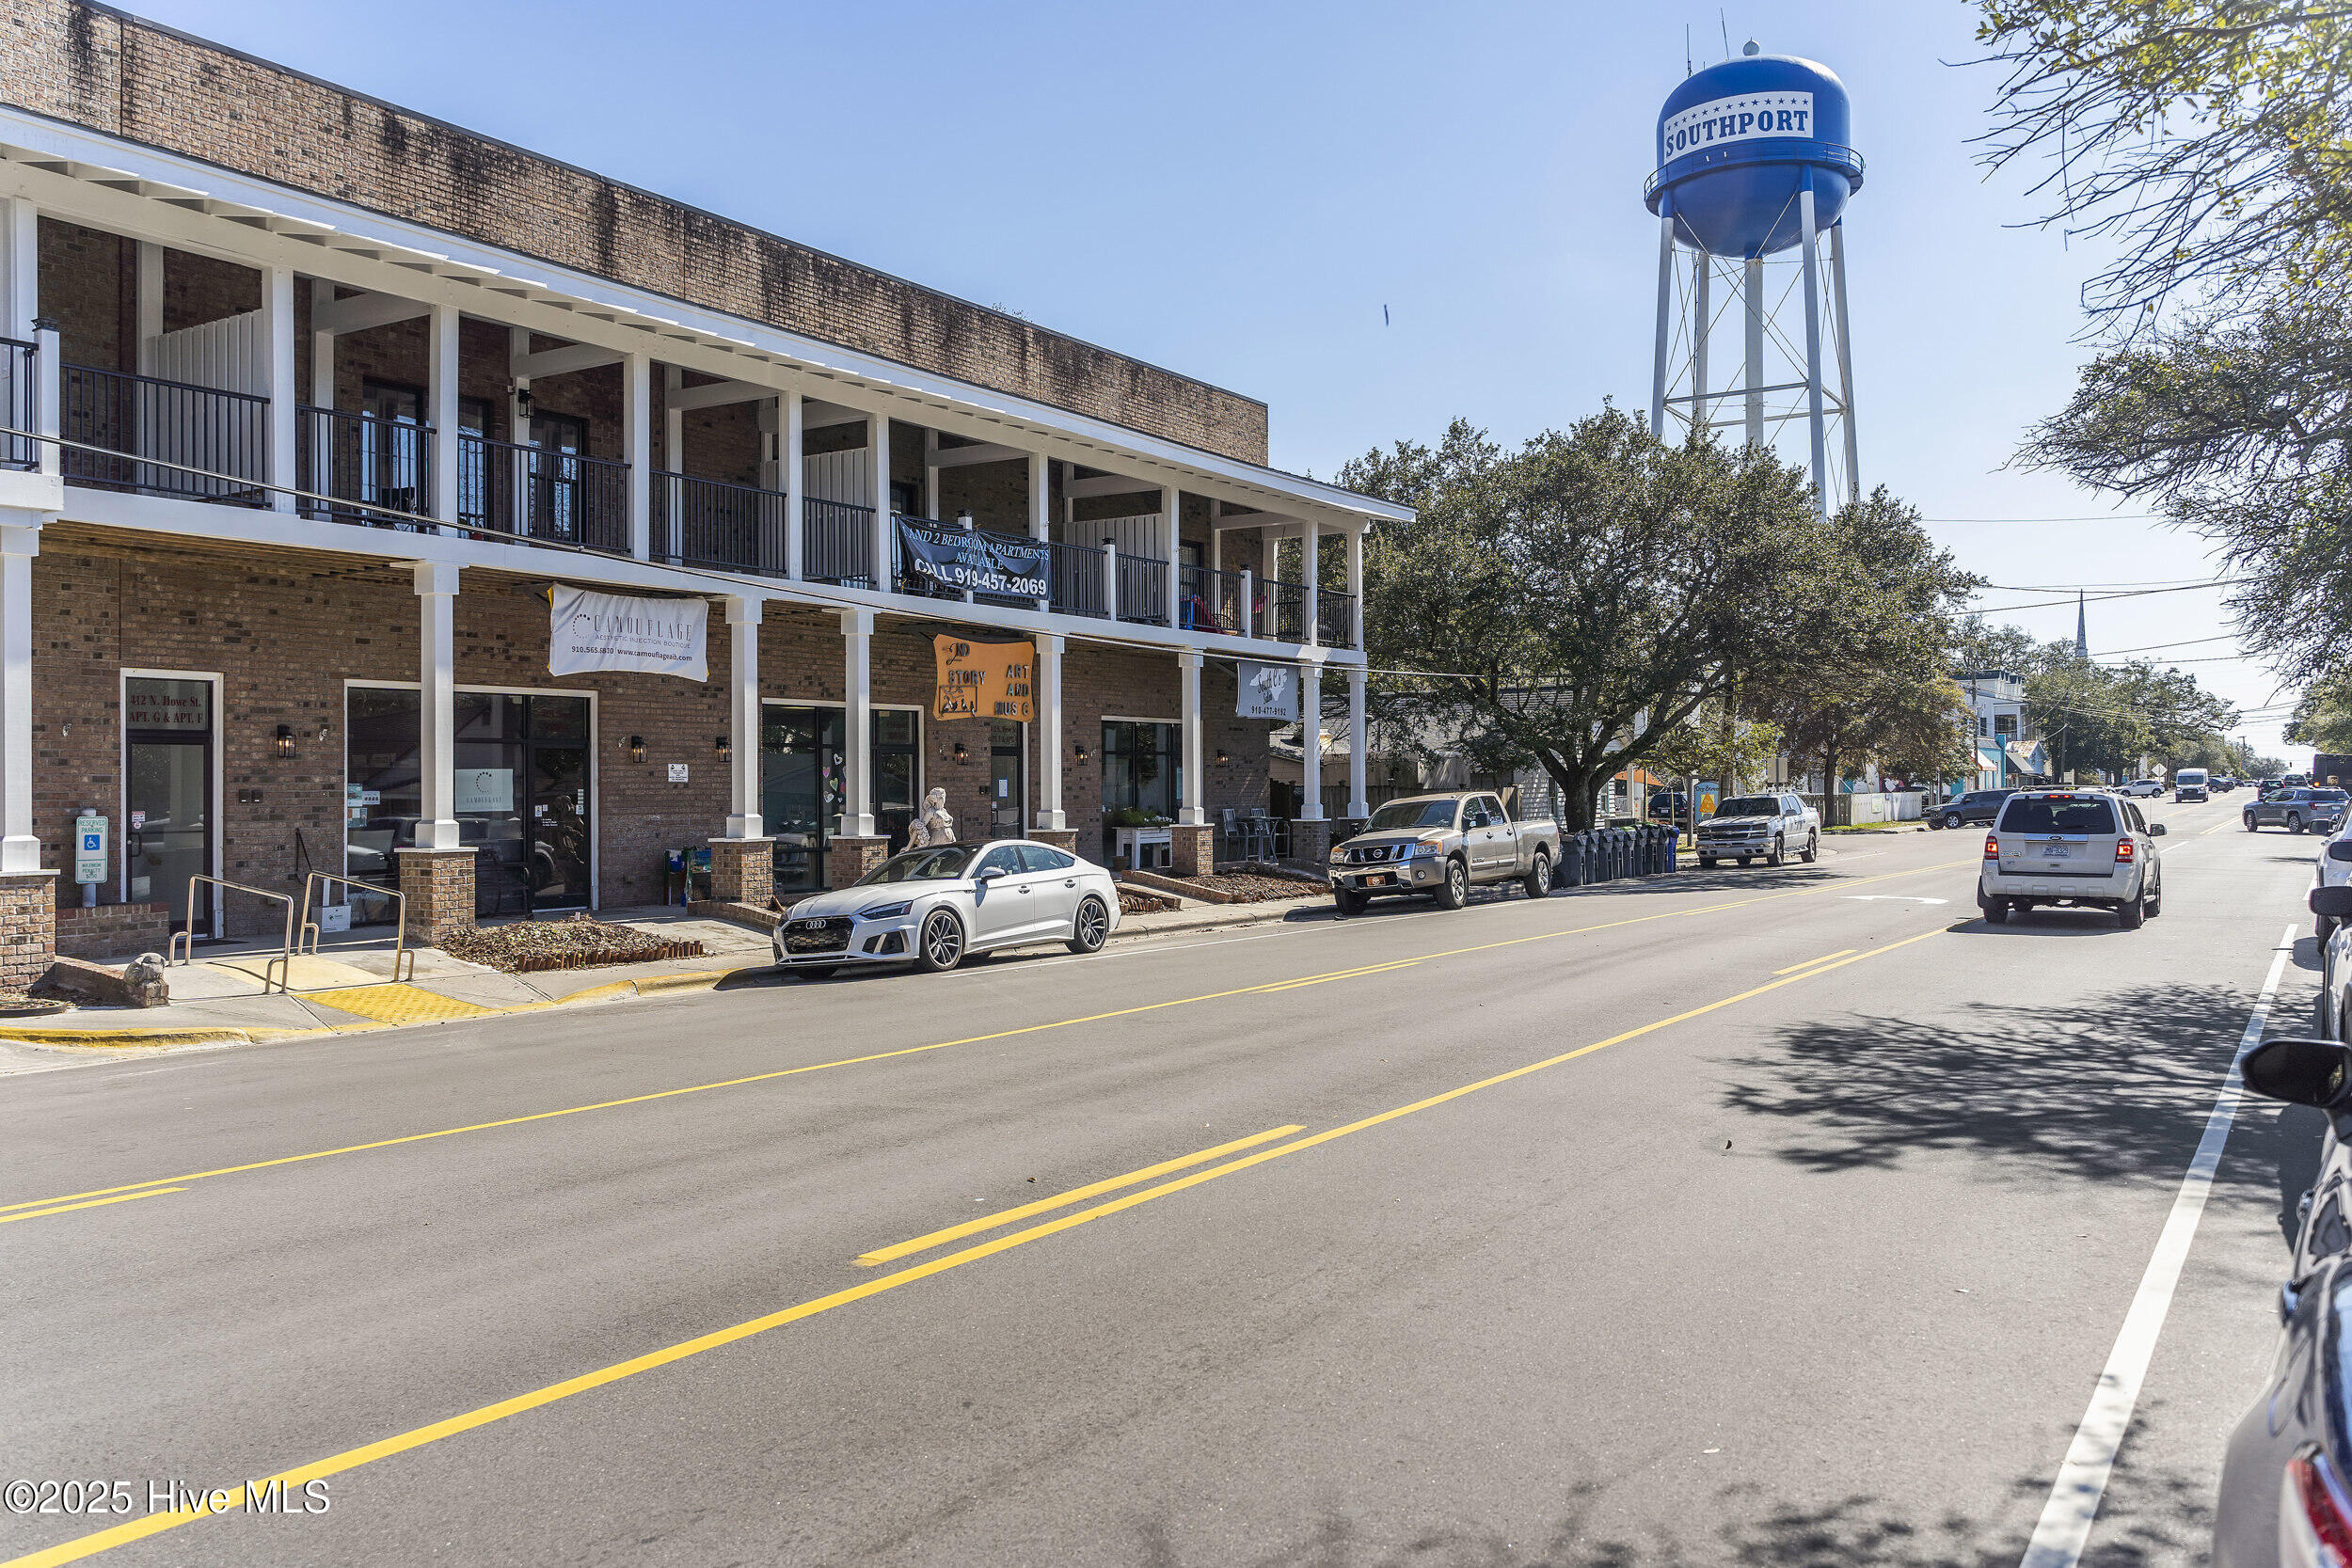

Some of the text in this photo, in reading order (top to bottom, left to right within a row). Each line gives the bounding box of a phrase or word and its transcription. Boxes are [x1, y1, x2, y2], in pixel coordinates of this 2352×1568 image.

[1666, 110, 1808, 158] SOUTHPORT
[908, 528, 932, 543] AND
[933, 531, 941, 544] 2
[942, 533, 987, 551] BEDROOM
[988, 542, 1050, 561] APARTMENTS
[955, 551, 1004, 570] AVAILABLE
[914, 558, 1047, 595] CALL 919-457-2069
[595, 614, 692, 641] CAMOUFLAGE
[629, 637, 661, 645] INJECTION
[663, 640, 691, 649] BOUTIQUE
[948, 670, 985, 685] STORY
[1006, 665, 1030, 678] ART
[1006, 683, 1029, 697] AND
[130, 695, 201, 707] 412 N. Howe St.
[128, 712, 150, 722] APT.
[153, 712, 160, 723] G
[163, 712, 170, 723] &
[174, 712, 194, 723] APT.
